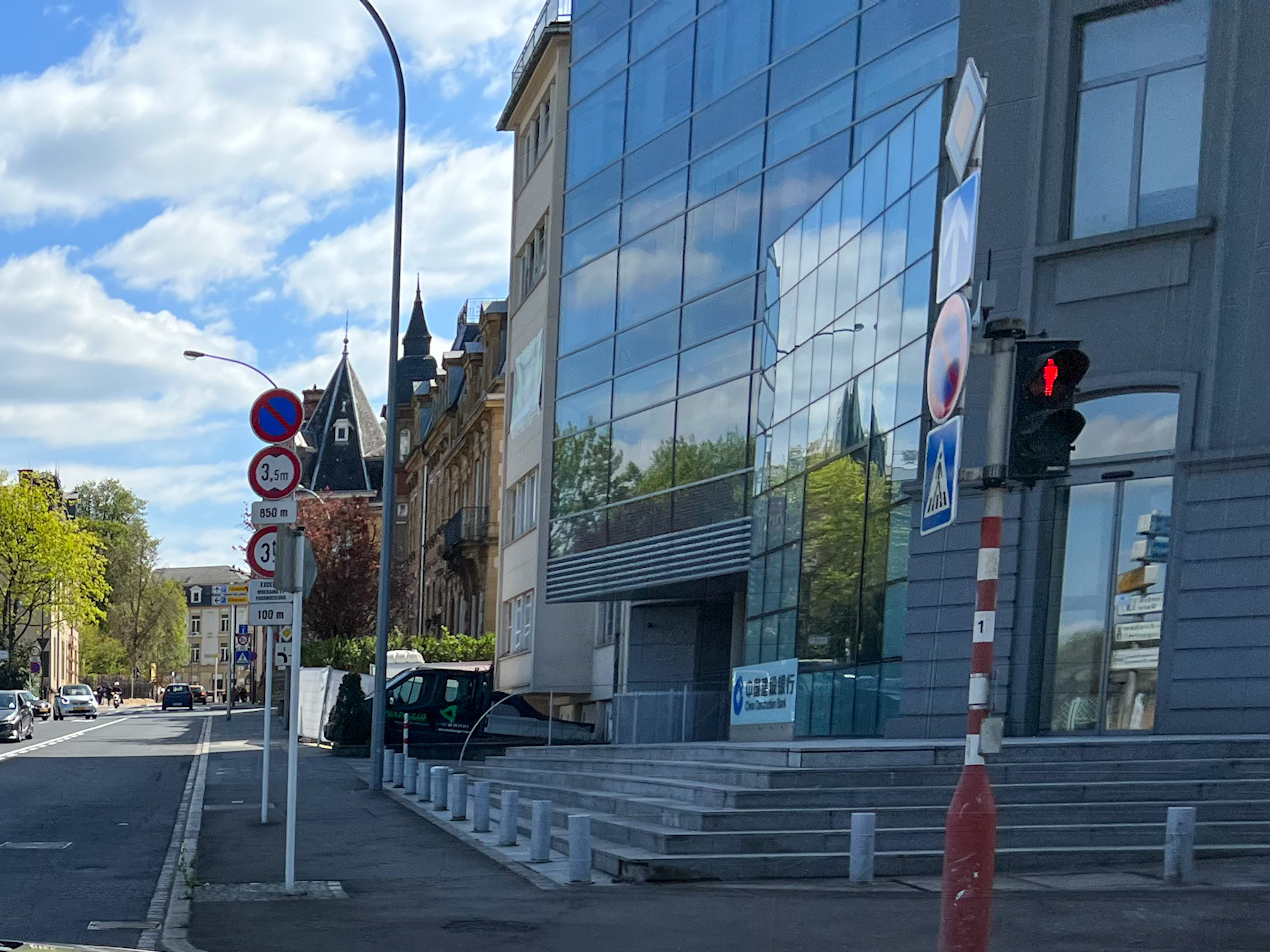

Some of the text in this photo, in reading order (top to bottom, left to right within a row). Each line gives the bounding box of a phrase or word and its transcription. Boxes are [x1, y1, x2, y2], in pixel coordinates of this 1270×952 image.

[259, 507, 288, 518] 850 m
[257, 609, 284, 620] 100 m
[977, 619, 983, 633] 1
